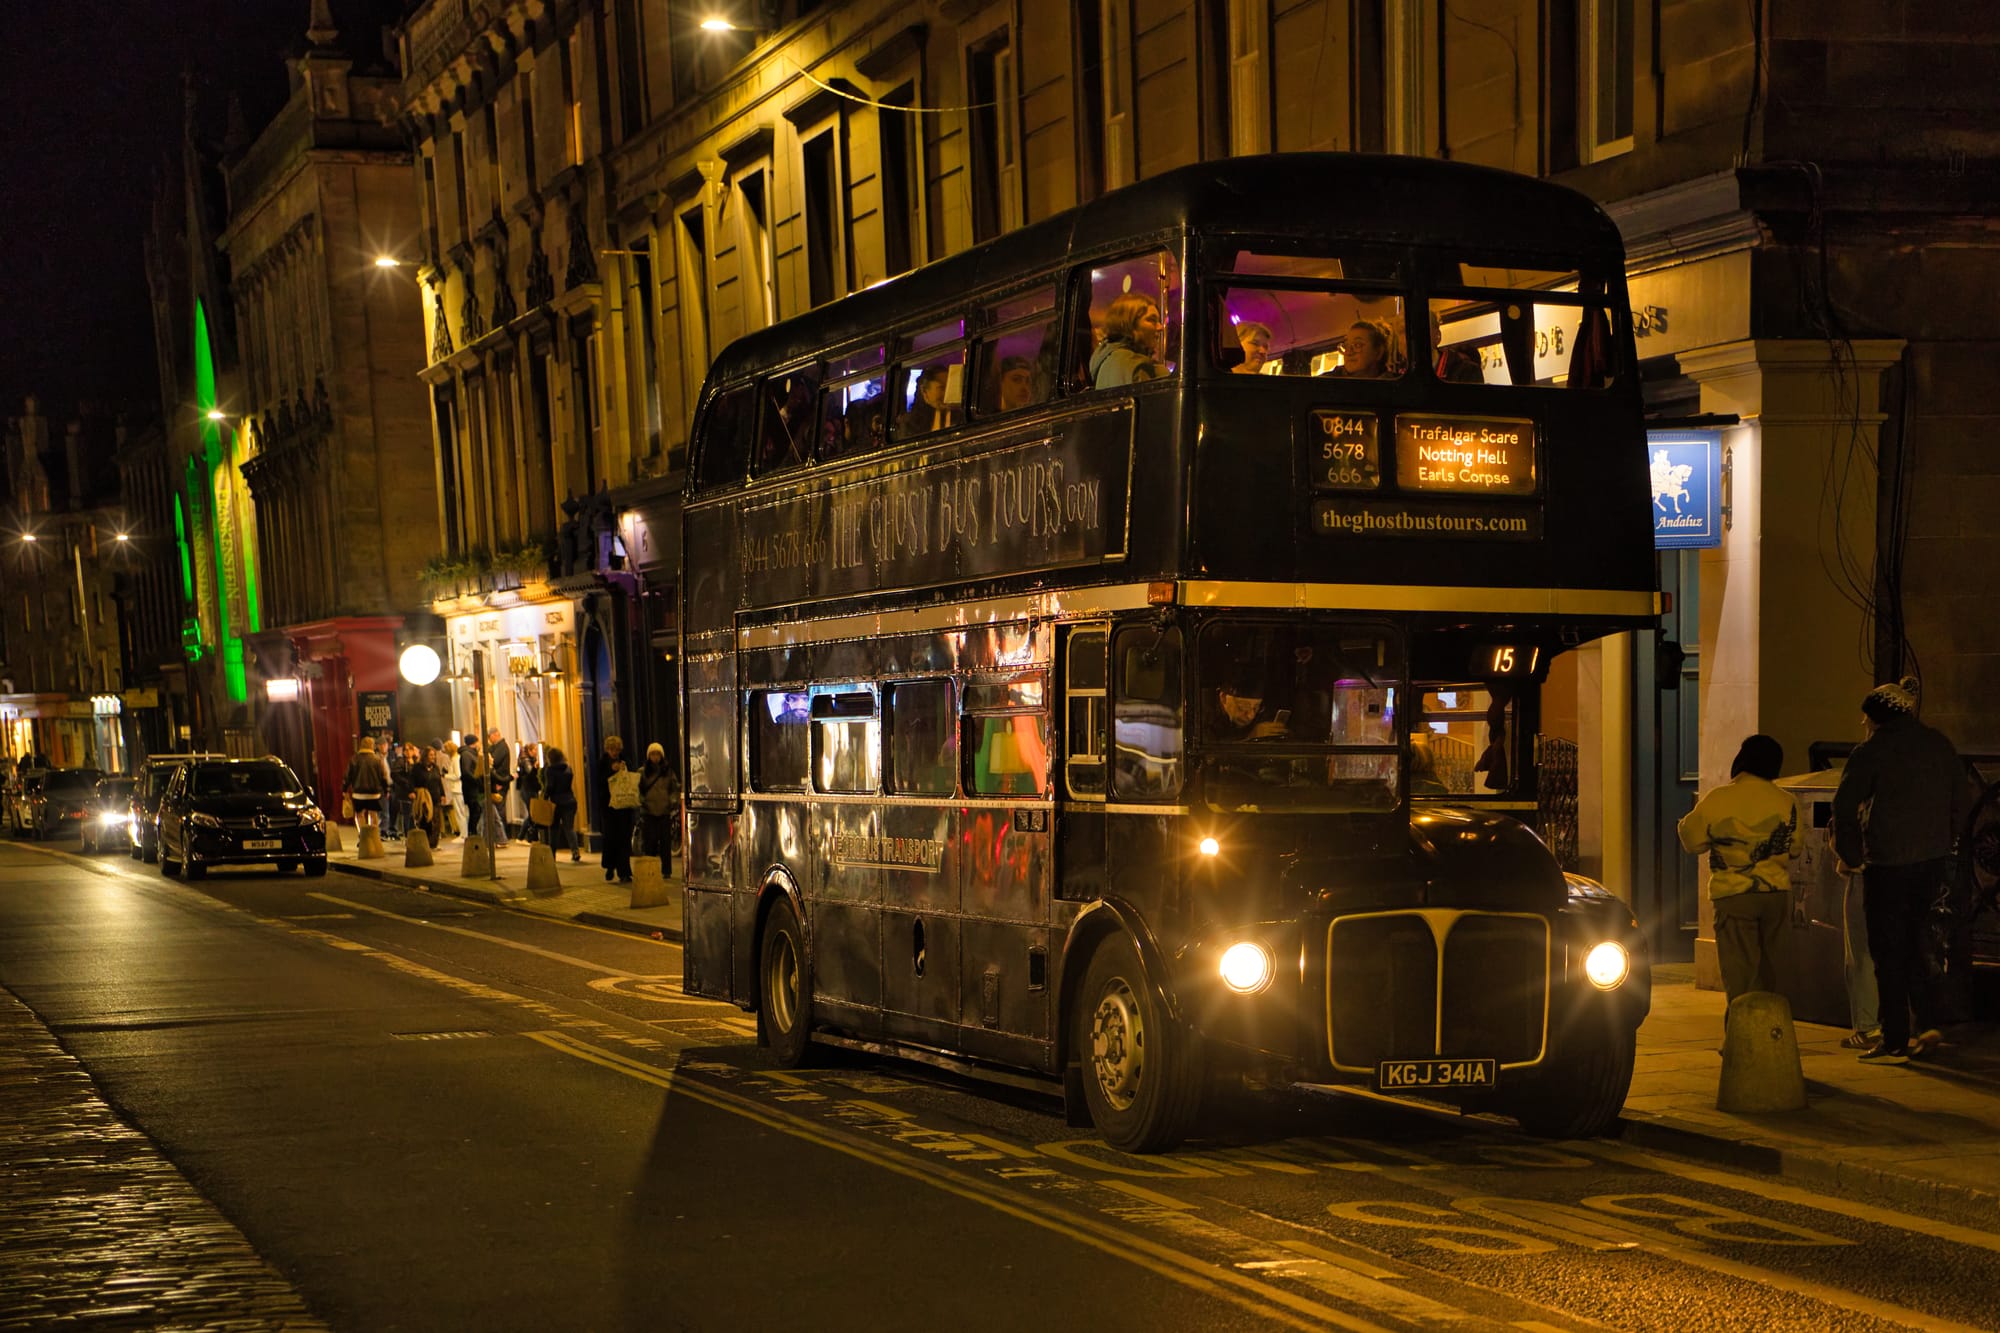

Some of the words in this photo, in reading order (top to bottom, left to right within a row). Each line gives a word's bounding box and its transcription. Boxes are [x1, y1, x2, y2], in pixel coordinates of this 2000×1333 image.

[1322, 417, 1364, 436] 0844
[1410, 424, 1476, 445] Trafalgar
[1480, 428, 1519, 445] Scare
[1322, 442, 1365, 460] 5678
[1419, 446, 1473, 467] Notting
[1477, 449, 1508, 465] Hell
[1327, 466, 1362, 484] 666
[1418, 467, 1455, 482] Earls
[1459, 469, 1510, 487] Corpse
[870, 484, 933, 562] GHOST
[940, 478, 981, 552] BUS
[1322, 509, 1527, 532] theghostbustours.com
[1655, 514, 1703, 529] Andaluz
[1493, 648, 1514, 672] 15
[881, 836, 944, 873] TRANSPORT
[1388, 1064, 1432, 1085] KGJ
[1438, 1063, 1486, 1083] 341A
